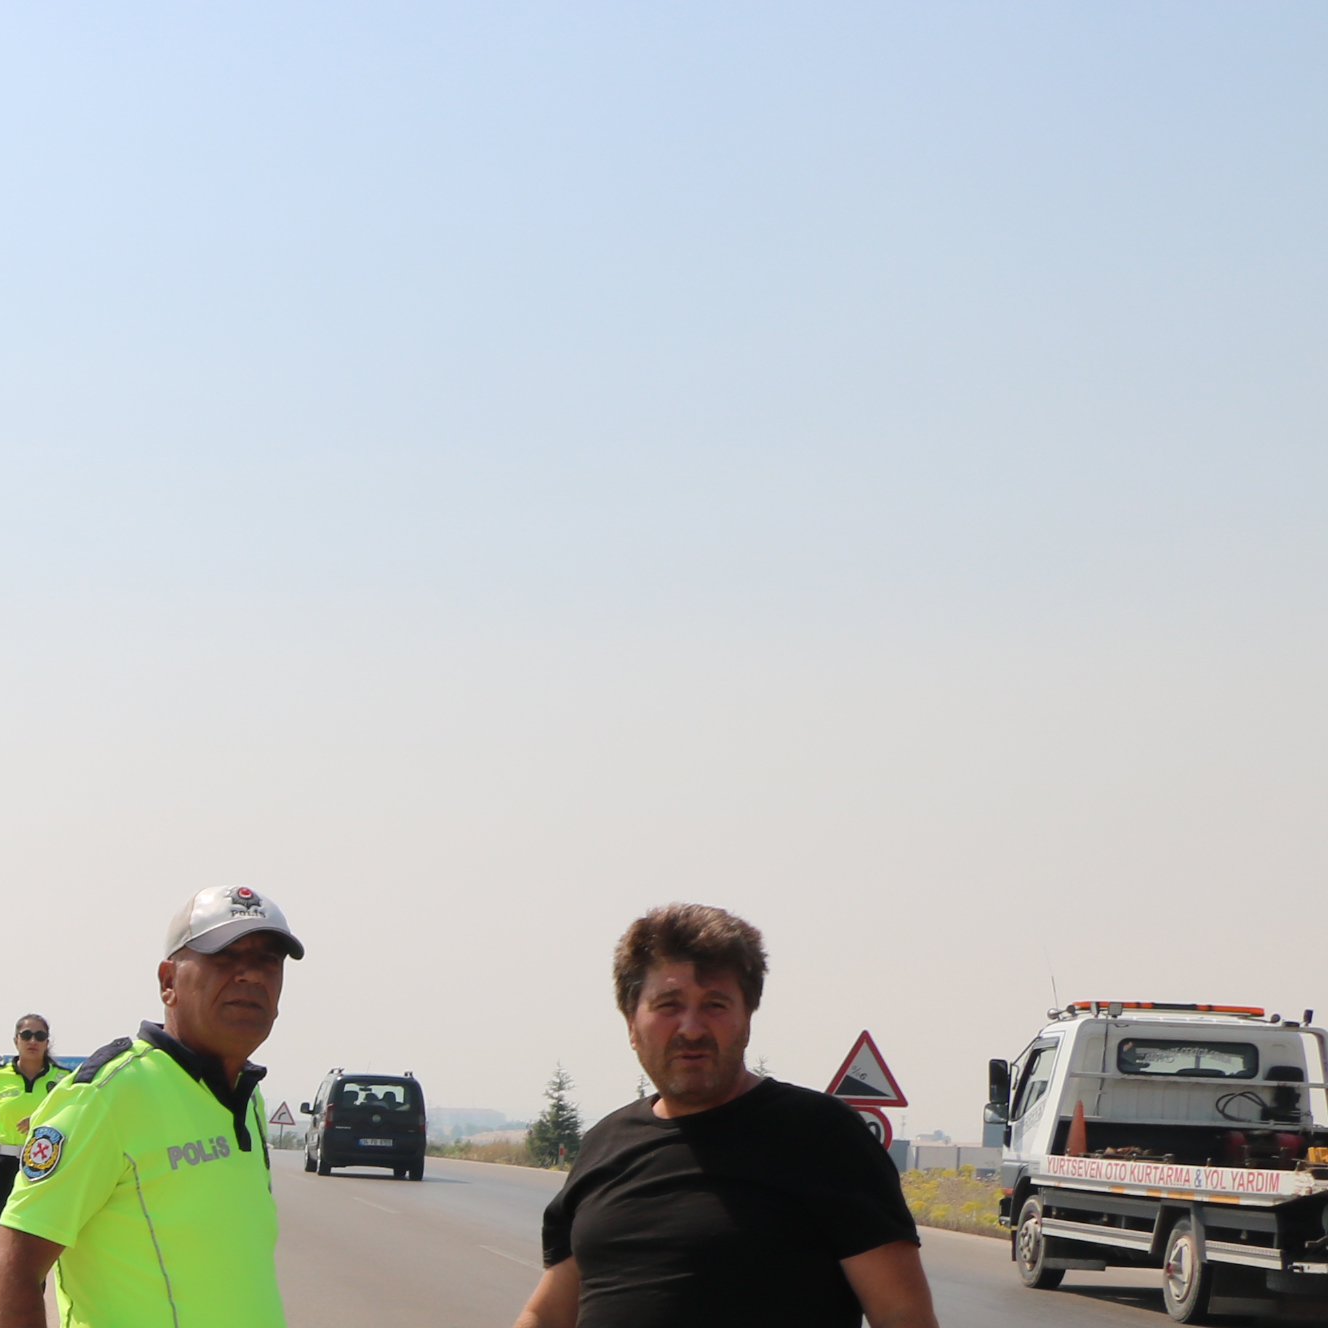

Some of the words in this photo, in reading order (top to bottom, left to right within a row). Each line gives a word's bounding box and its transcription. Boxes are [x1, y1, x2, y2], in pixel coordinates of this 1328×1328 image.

[851, 1065, 868, 1080] %6
[1047, 1157, 1102, 1180] YURTSEVEN
[1105, 1162, 1127, 1181] OTO
[1130, 1164, 1191, 1186] KURTARMA
[1195, 1168, 1202, 1188] &
[1204, 1169, 1226, 1190] YOL
[1230, 1172, 1281, 1193] YARDIM
